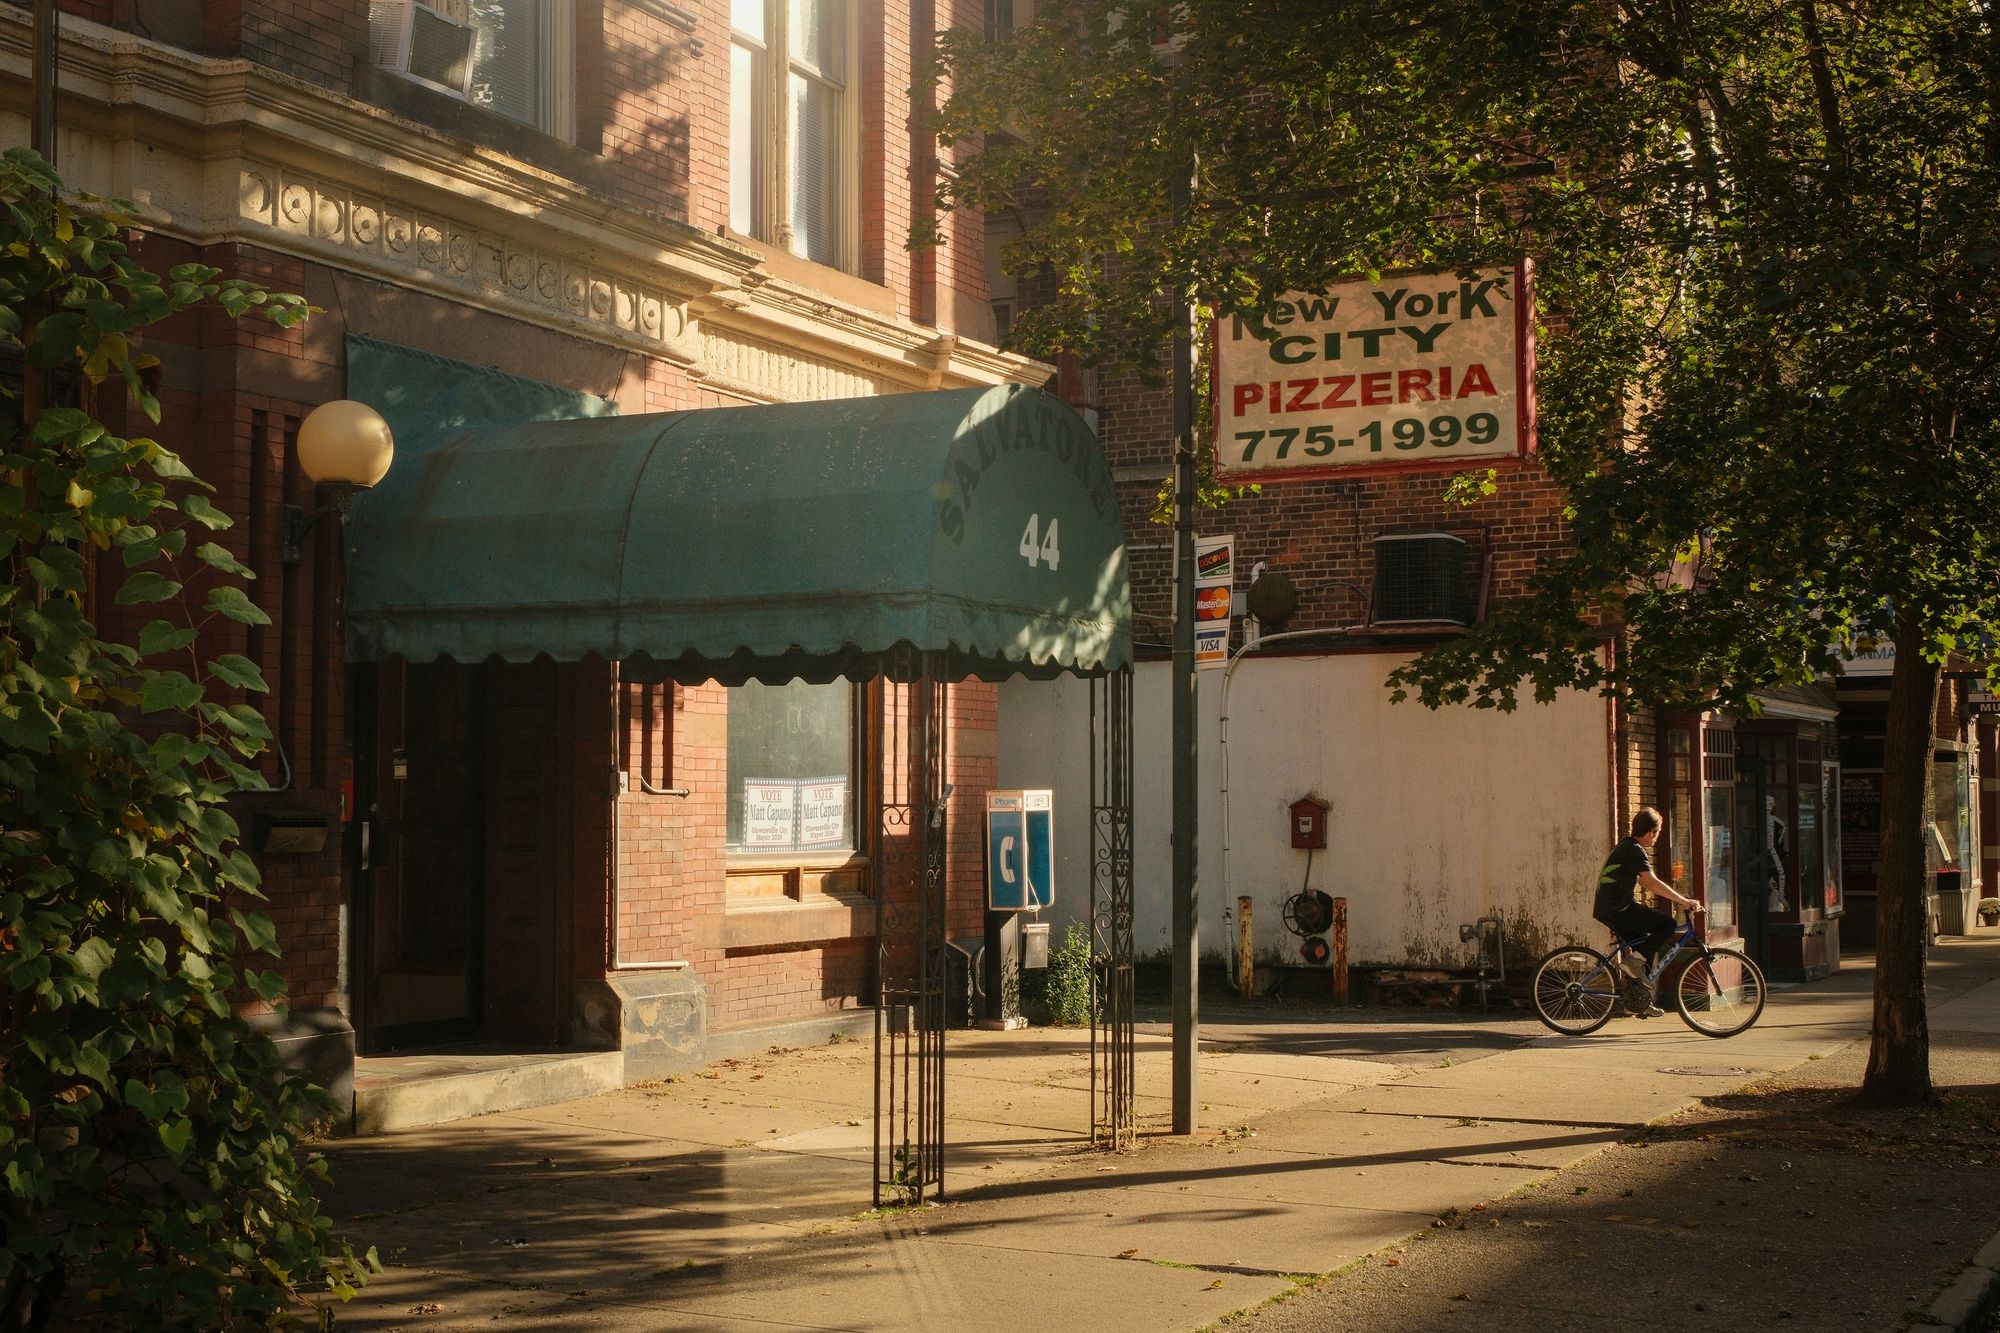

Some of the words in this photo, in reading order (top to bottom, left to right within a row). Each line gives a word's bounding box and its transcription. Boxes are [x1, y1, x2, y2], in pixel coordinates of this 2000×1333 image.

[1269, 322, 1453, 365] CITY
[1233, 363, 1499, 418] PIZZERIA
[1235, 412, 1500, 463] 775-1999
[1019, 513, 1060, 571] 44
[1196, 599, 1229, 610] MasterCard
[1200, 639, 1220, 652] VISA
[760, 789, 782, 801] VOTE
[813, 788, 834, 799] VOTE
[995, 797, 1017, 805] Phone
[749, 804, 765, 821] Matt
[766, 803, 792, 826] Capano
[803, 803, 818, 820] Matt
[819, 802, 843, 822] Capano
